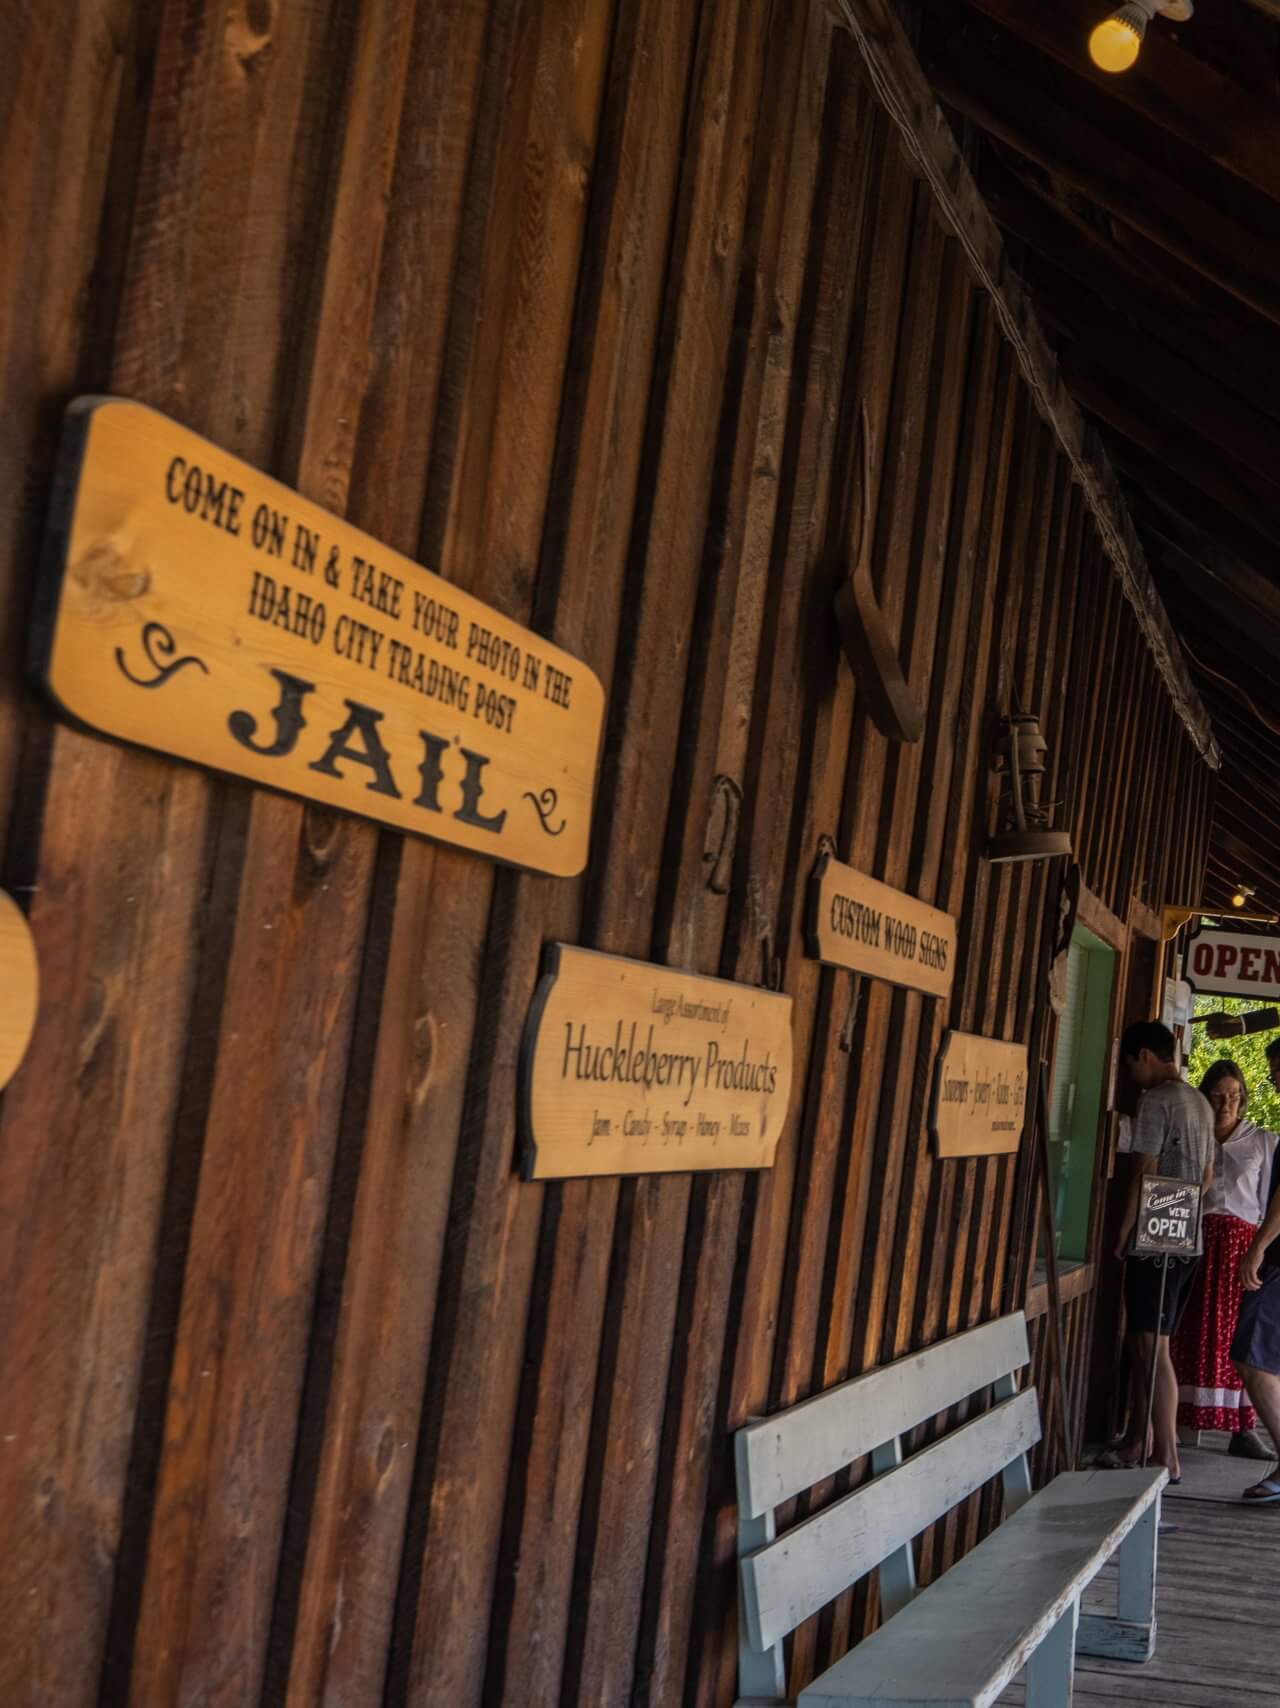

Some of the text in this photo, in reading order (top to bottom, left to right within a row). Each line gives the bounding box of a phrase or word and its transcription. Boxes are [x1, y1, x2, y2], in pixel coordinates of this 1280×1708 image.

[166, 456, 573, 710] COME ON IN & TAKE YOUR PHOTO IN THE
[248, 570, 517, 733] IDAHO CITY TRADING POST
[228, 667, 508, 834] JAIL
[830, 893, 948, 971] CUSTOM WOOD SIGNS
[561, 1019, 777, 1107] Huckleberry Products
[1147, 1189, 1187, 1208] Come in
[1147, 1217, 1187, 1238] OPEN
